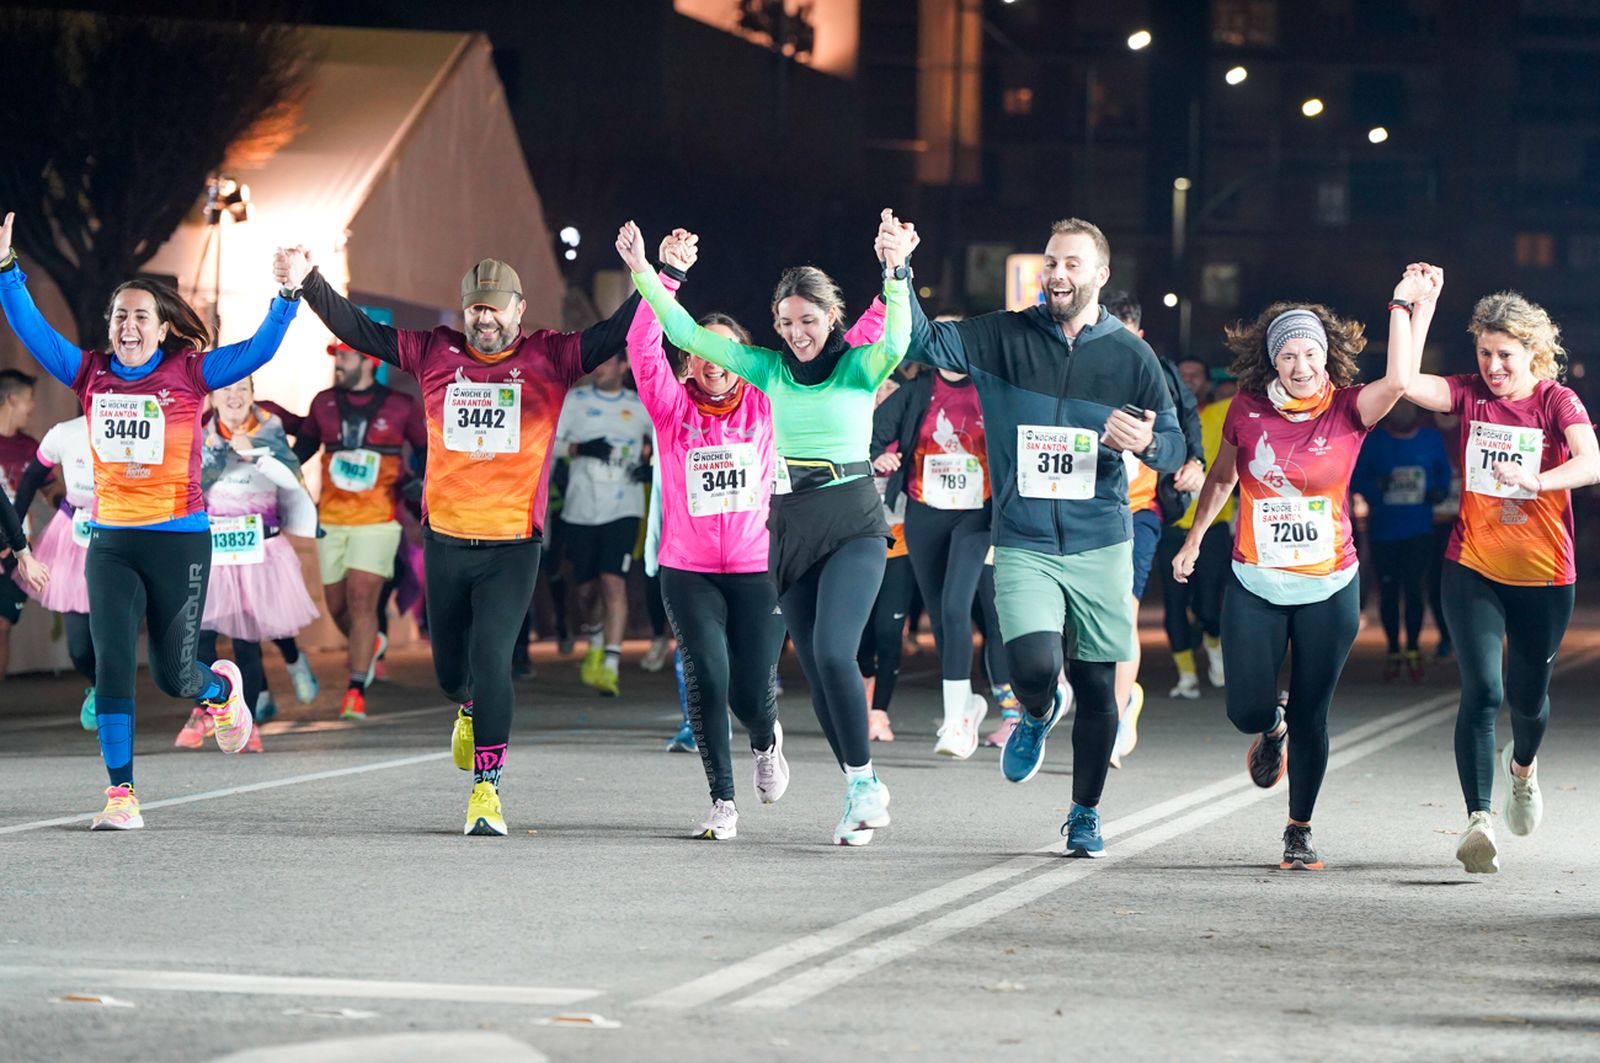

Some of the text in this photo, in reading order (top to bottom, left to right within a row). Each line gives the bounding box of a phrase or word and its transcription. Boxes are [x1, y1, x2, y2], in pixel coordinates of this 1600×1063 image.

[458, 408, 505, 428] 3442
[105, 419, 150, 439] 3440
[1035, 434, 1058, 442] NOCHE
[701, 453, 723, 461] NOCHE
[1038, 452, 1073, 474] 318
[693, 462, 708, 471] SAN
[702, 468, 746, 491] 3441
[940, 474, 966, 489] 789
[1263, 470, 1283, 488] 43
[1271, 504, 1292, 512] NOCHE
[1263, 514, 1278, 522] SAN
[213, 531, 255, 548] 13832
[1271, 521, 1318, 542] 7206
[180, 563, 203, 679] ARMOUR
